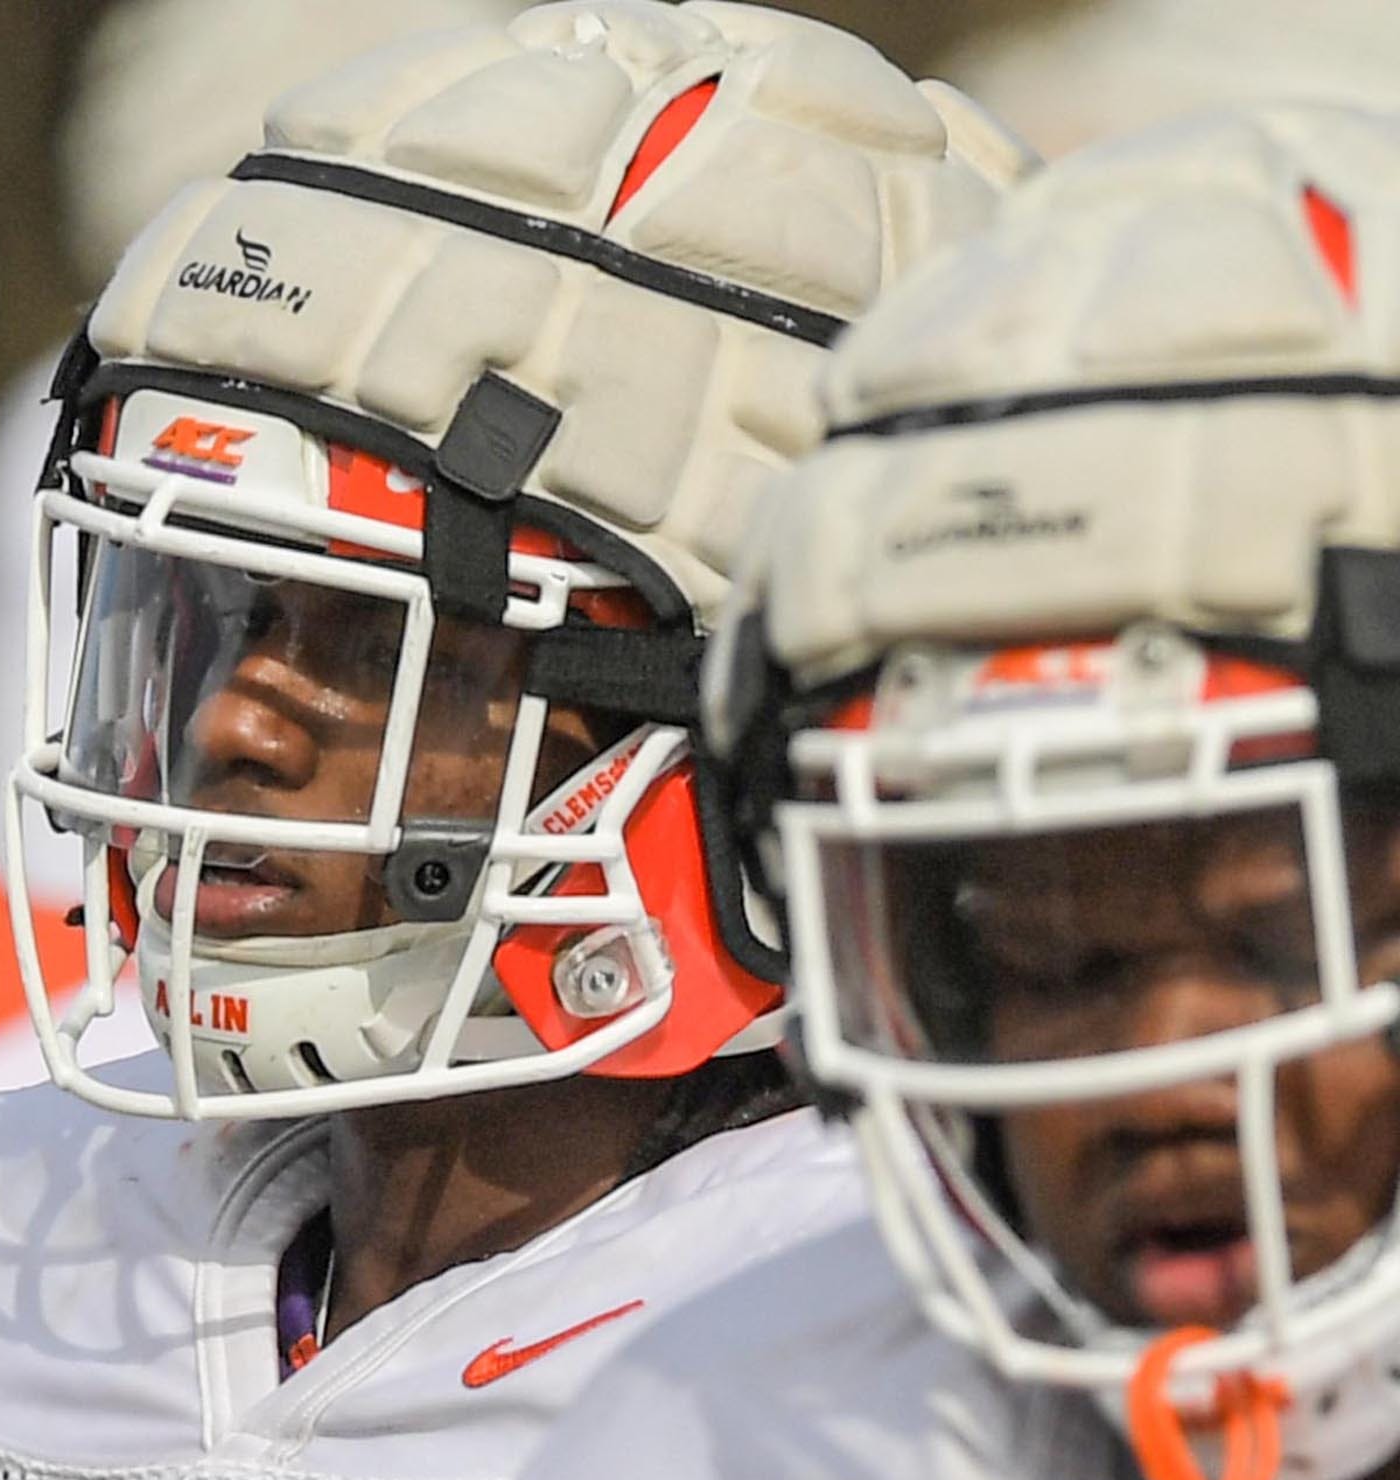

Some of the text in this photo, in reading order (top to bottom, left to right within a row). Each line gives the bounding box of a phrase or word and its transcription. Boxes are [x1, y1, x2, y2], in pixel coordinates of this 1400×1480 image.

[178, 261, 312, 314] GUARDIAN
[155, 978, 248, 1033] AL IN
